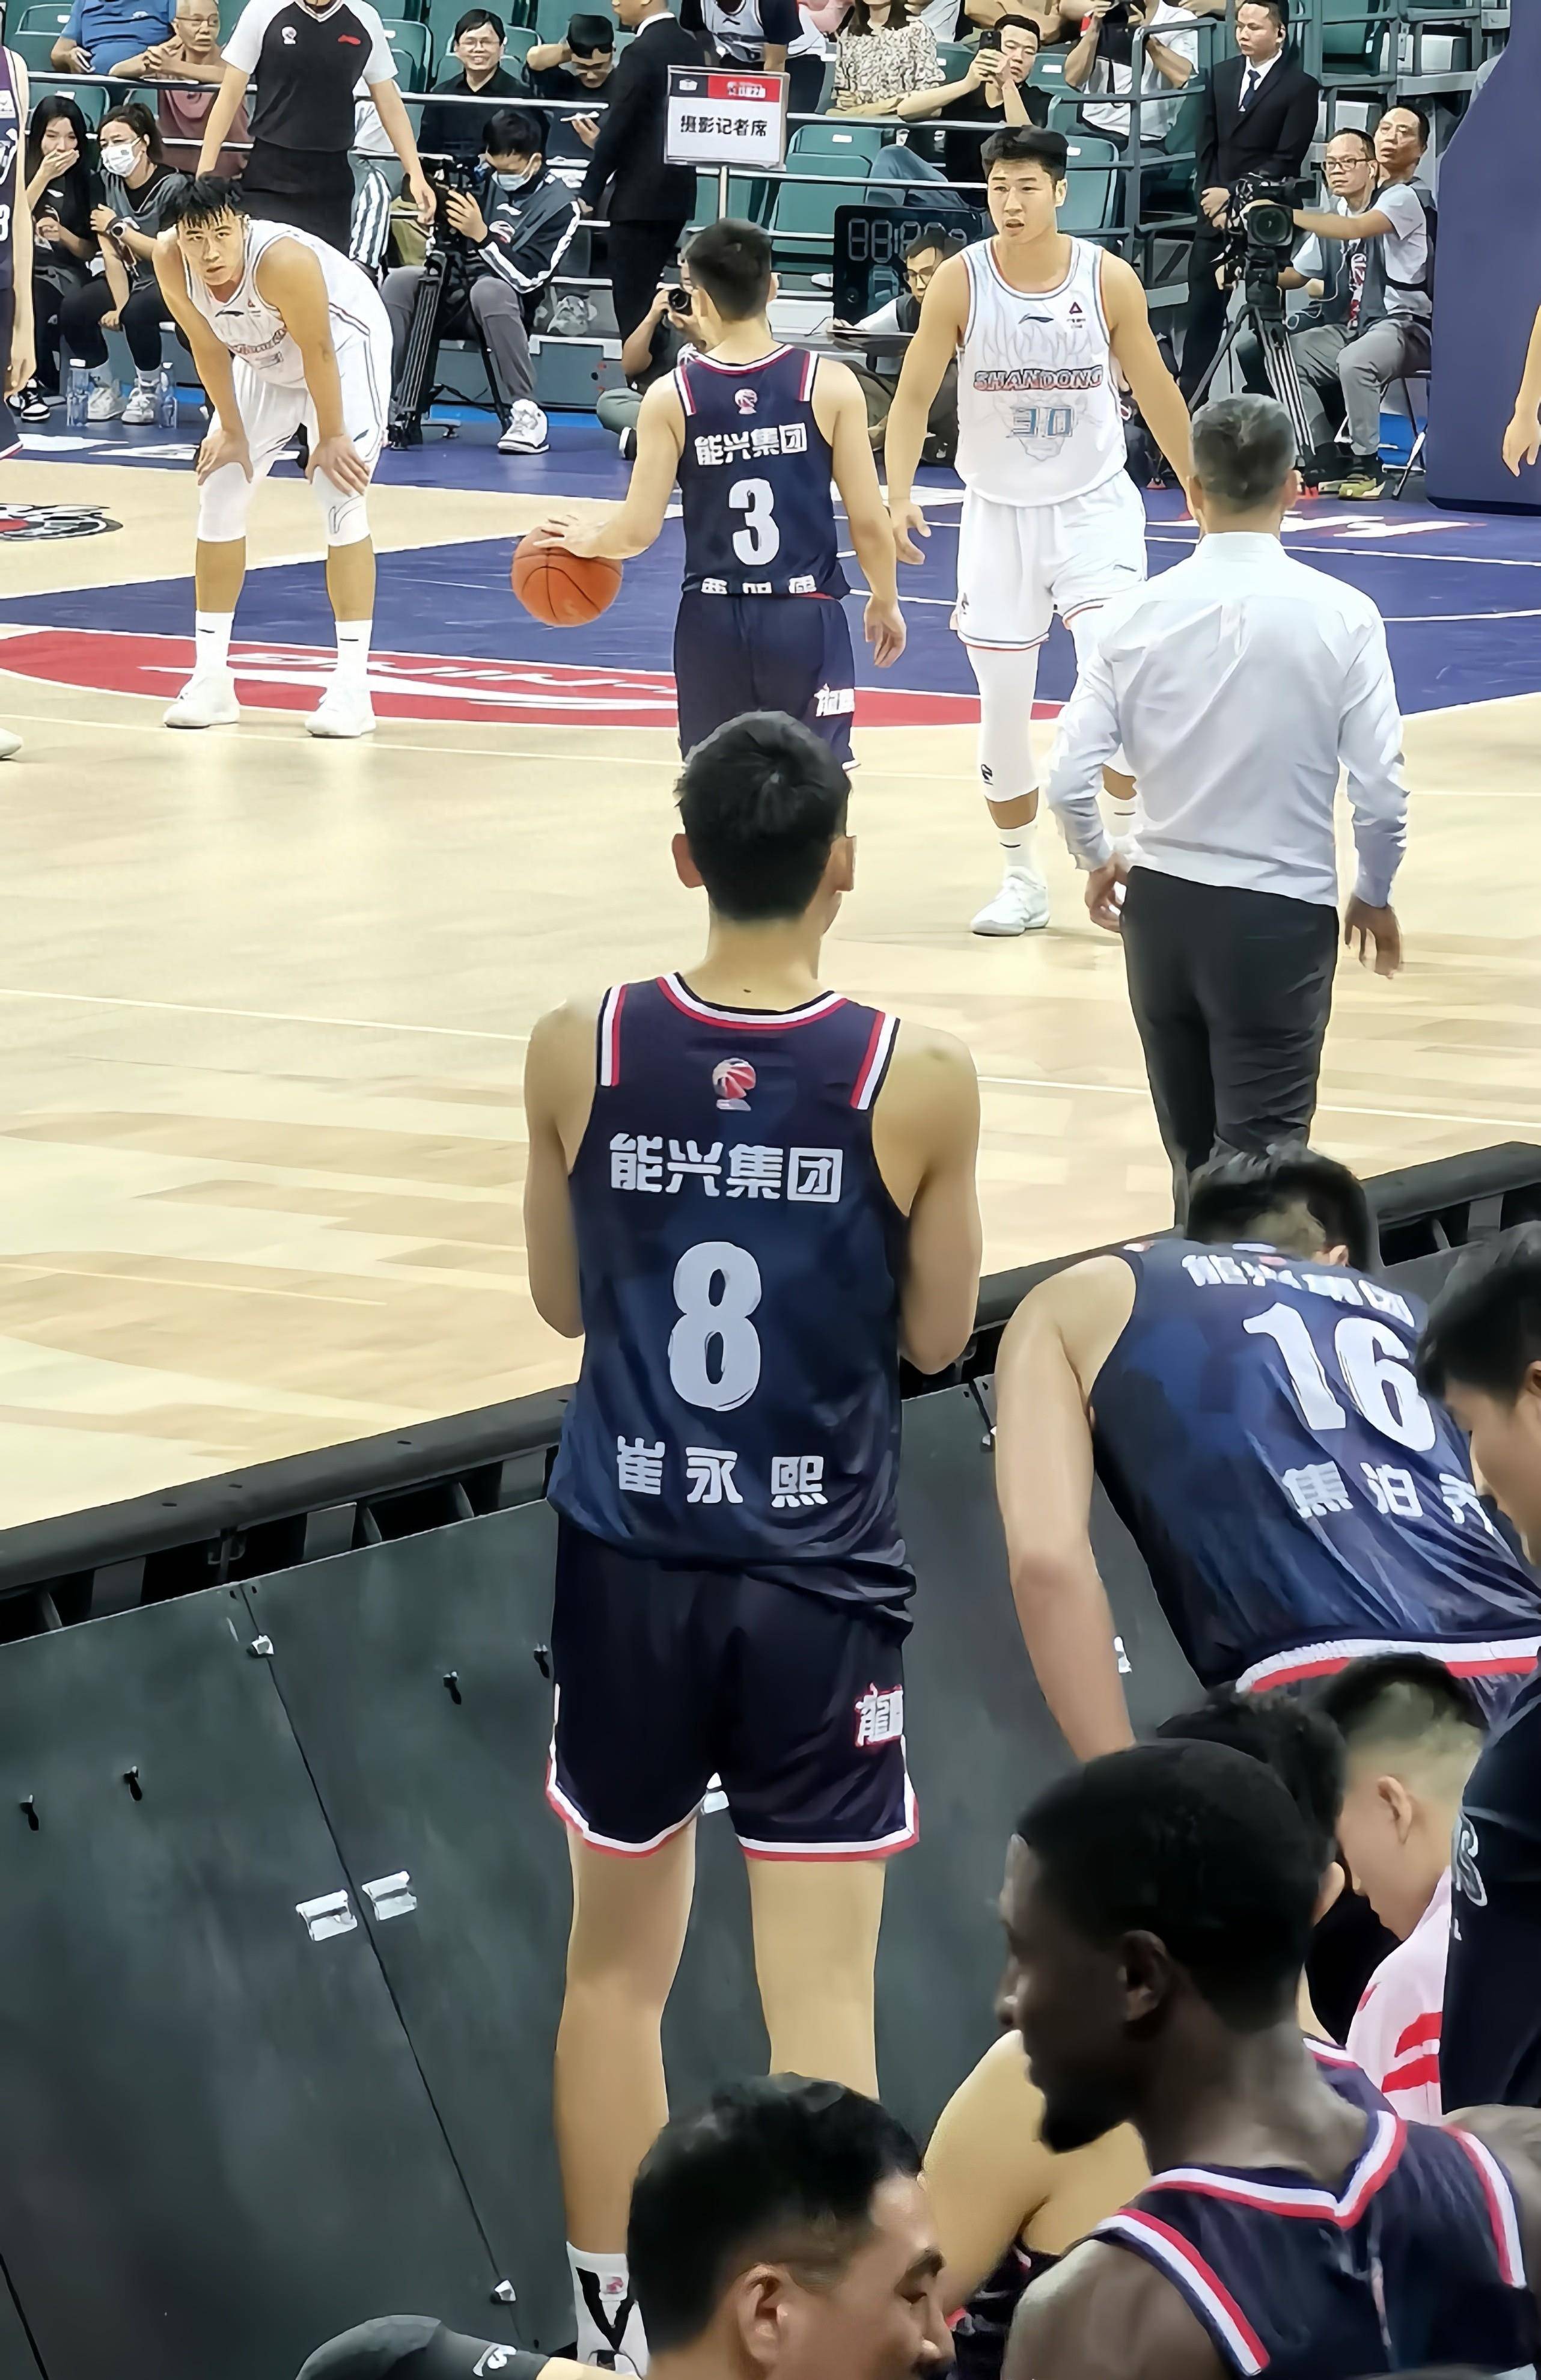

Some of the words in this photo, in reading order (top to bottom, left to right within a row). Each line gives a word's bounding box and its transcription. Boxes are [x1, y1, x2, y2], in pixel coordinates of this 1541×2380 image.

[973, 364, 1103, 391] SHANDONG
[694, 423, 807, 465] 能兴集团
[1007, 405, 1075, 438] 30
[728, 478, 780, 565] 3
[609, 1132, 843, 1203] 能兴集团
[668, 1241, 762, 1412] 8
[1243, 1302, 1436, 1451] 16
[616, 1434, 829, 1508] 崔永熙
